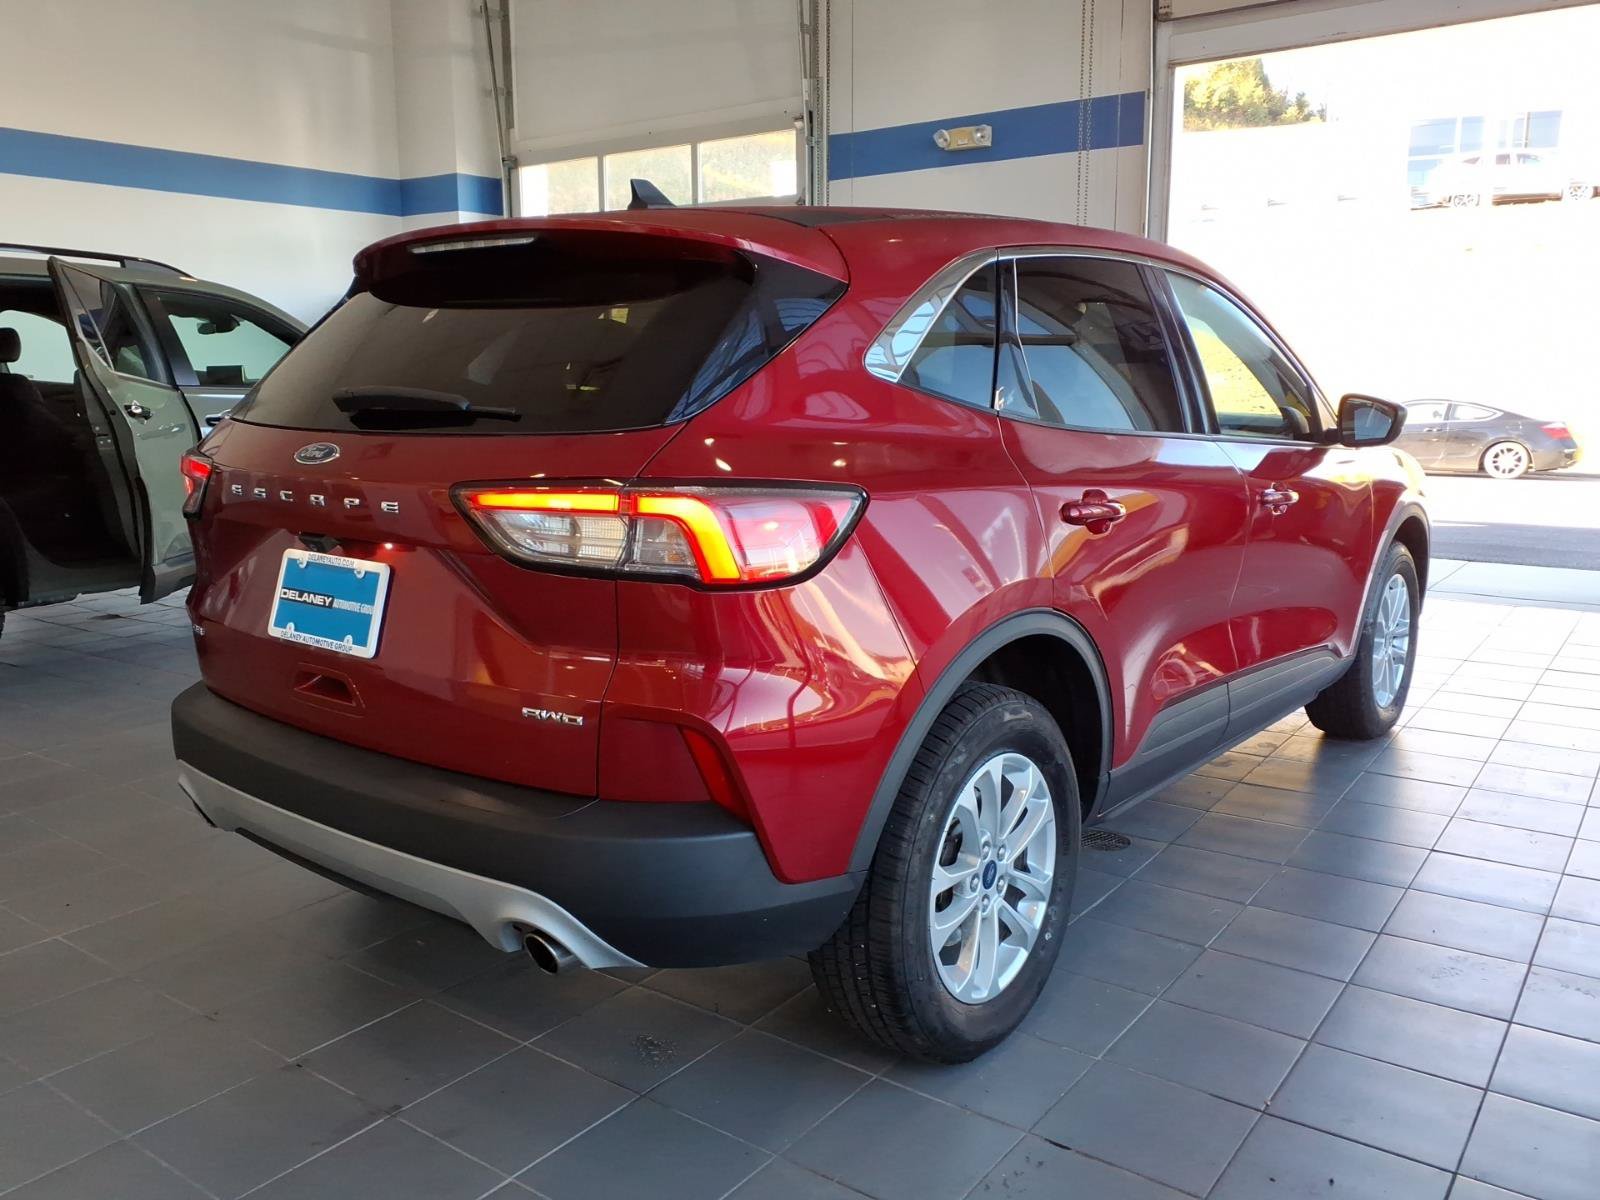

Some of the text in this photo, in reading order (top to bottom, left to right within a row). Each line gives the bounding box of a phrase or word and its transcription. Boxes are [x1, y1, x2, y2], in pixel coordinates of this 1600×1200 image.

[298, 444, 333, 460] Ford
[231, 484, 399, 513] ESCAPE
[307, 553, 355, 568] DELANEYAUTO.COM
[280, 588, 333, 607] DELANEY
[281, 630, 353, 654] DELANEY AUTOMOTIVE GROUP
[522, 706, 583, 726] AWD
